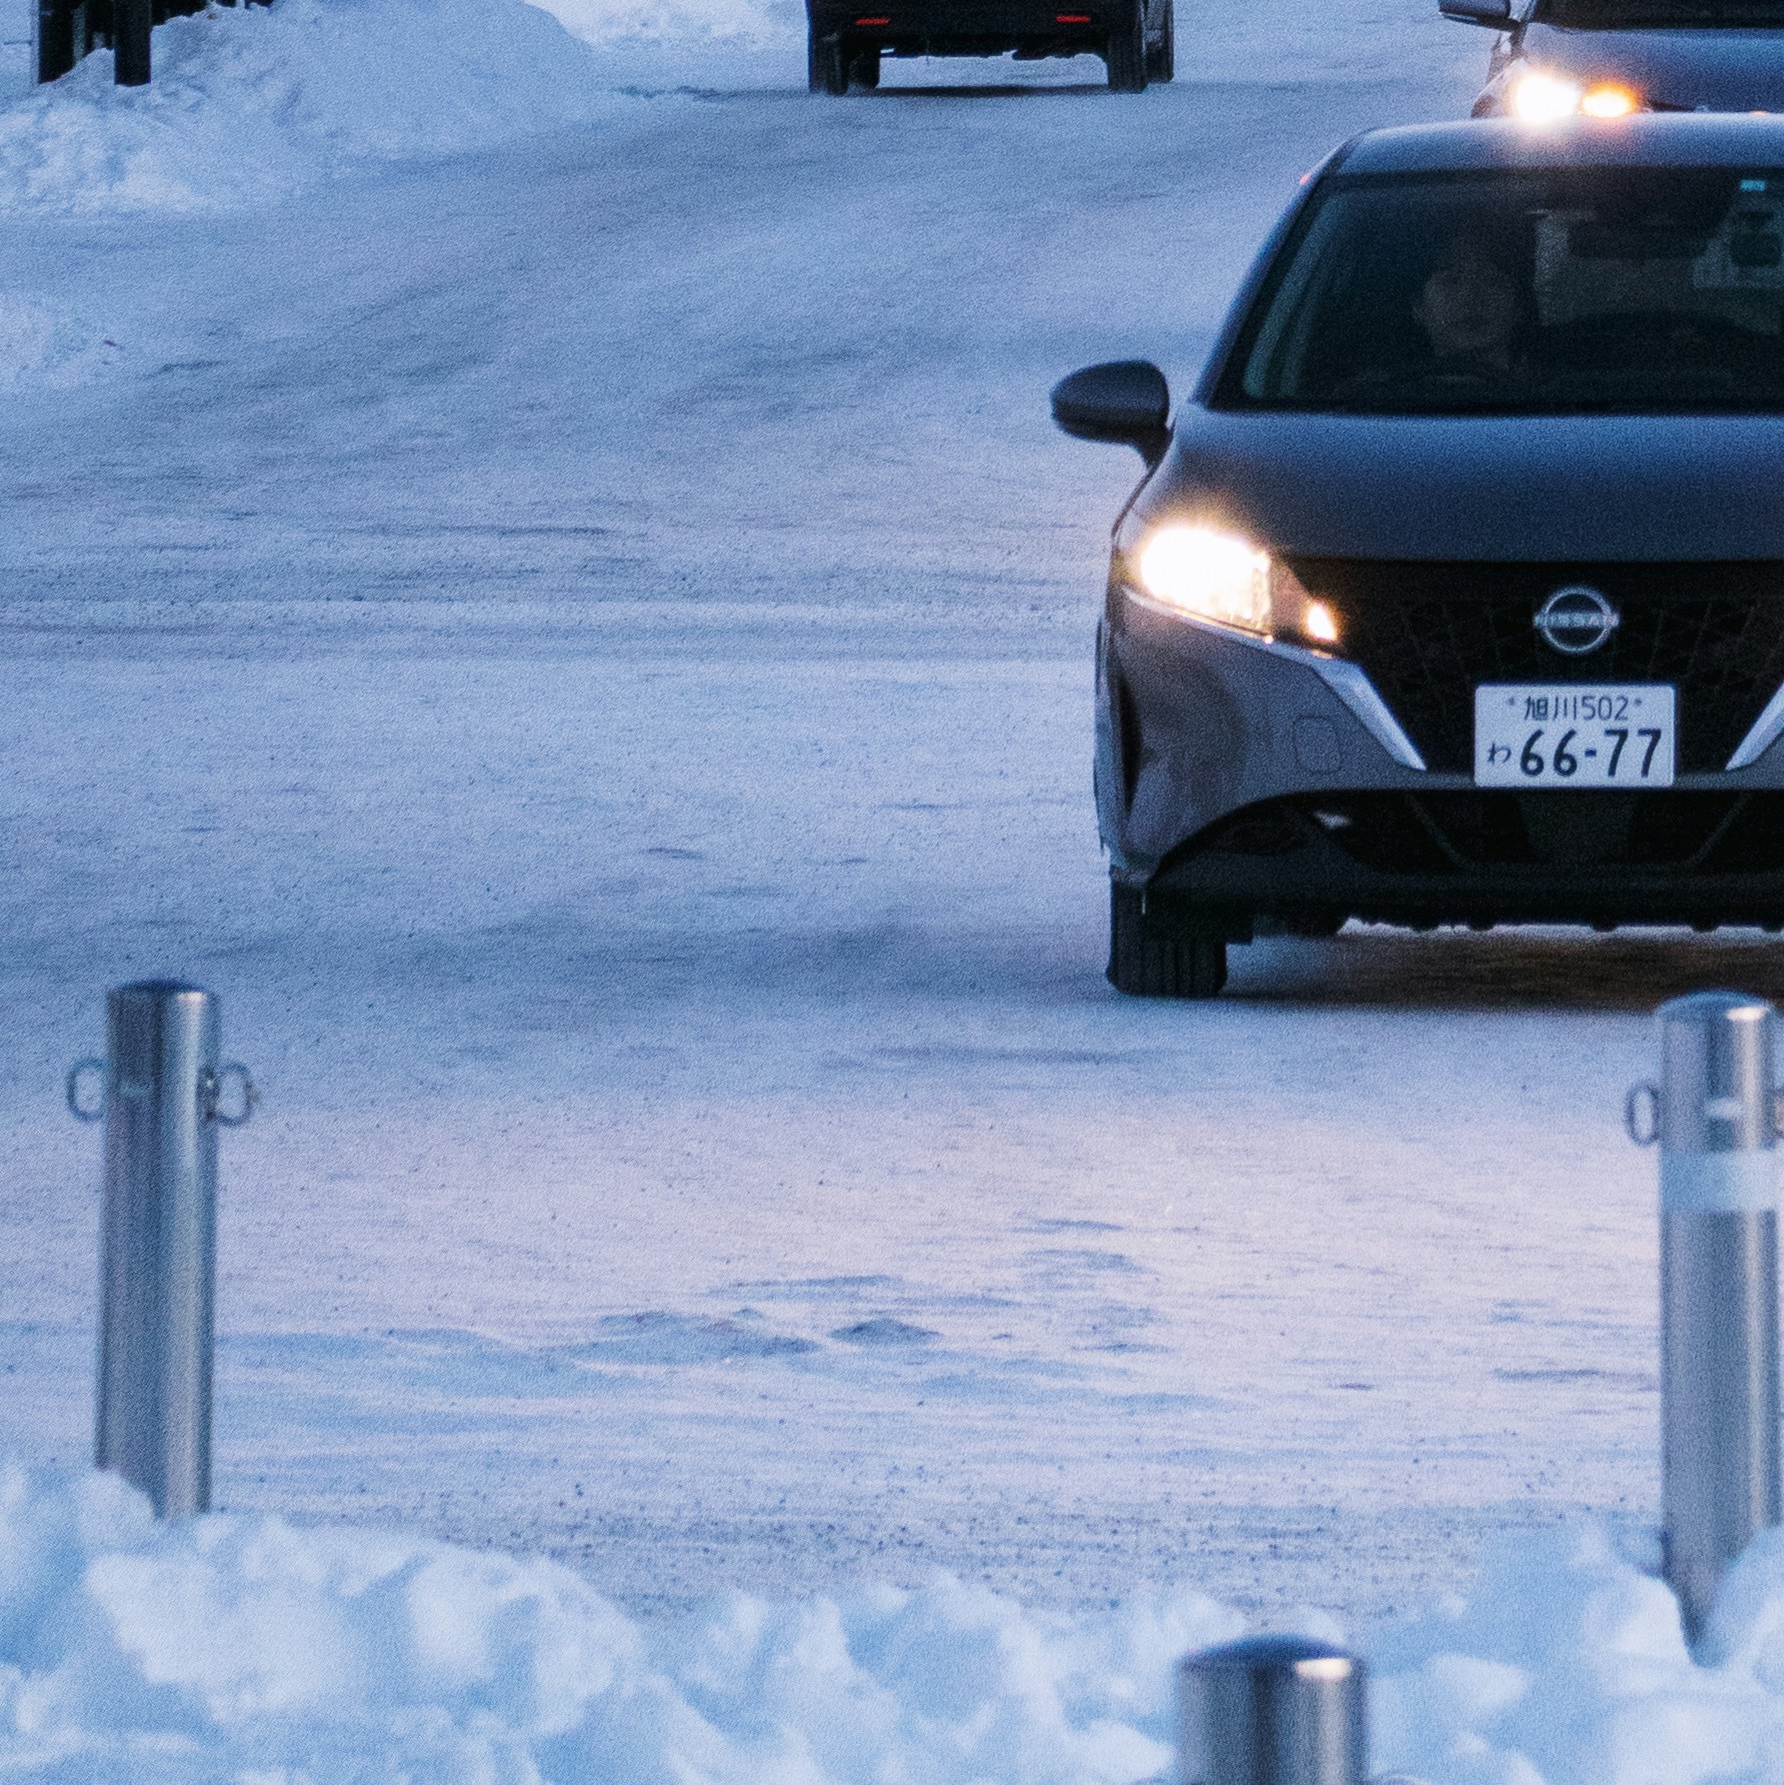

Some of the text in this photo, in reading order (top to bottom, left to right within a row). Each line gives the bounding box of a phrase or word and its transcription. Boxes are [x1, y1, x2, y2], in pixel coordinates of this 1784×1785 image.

[1534, 611, 1620, 628] NISSAN
[1486, 728, 1662, 777] わ 66-77
